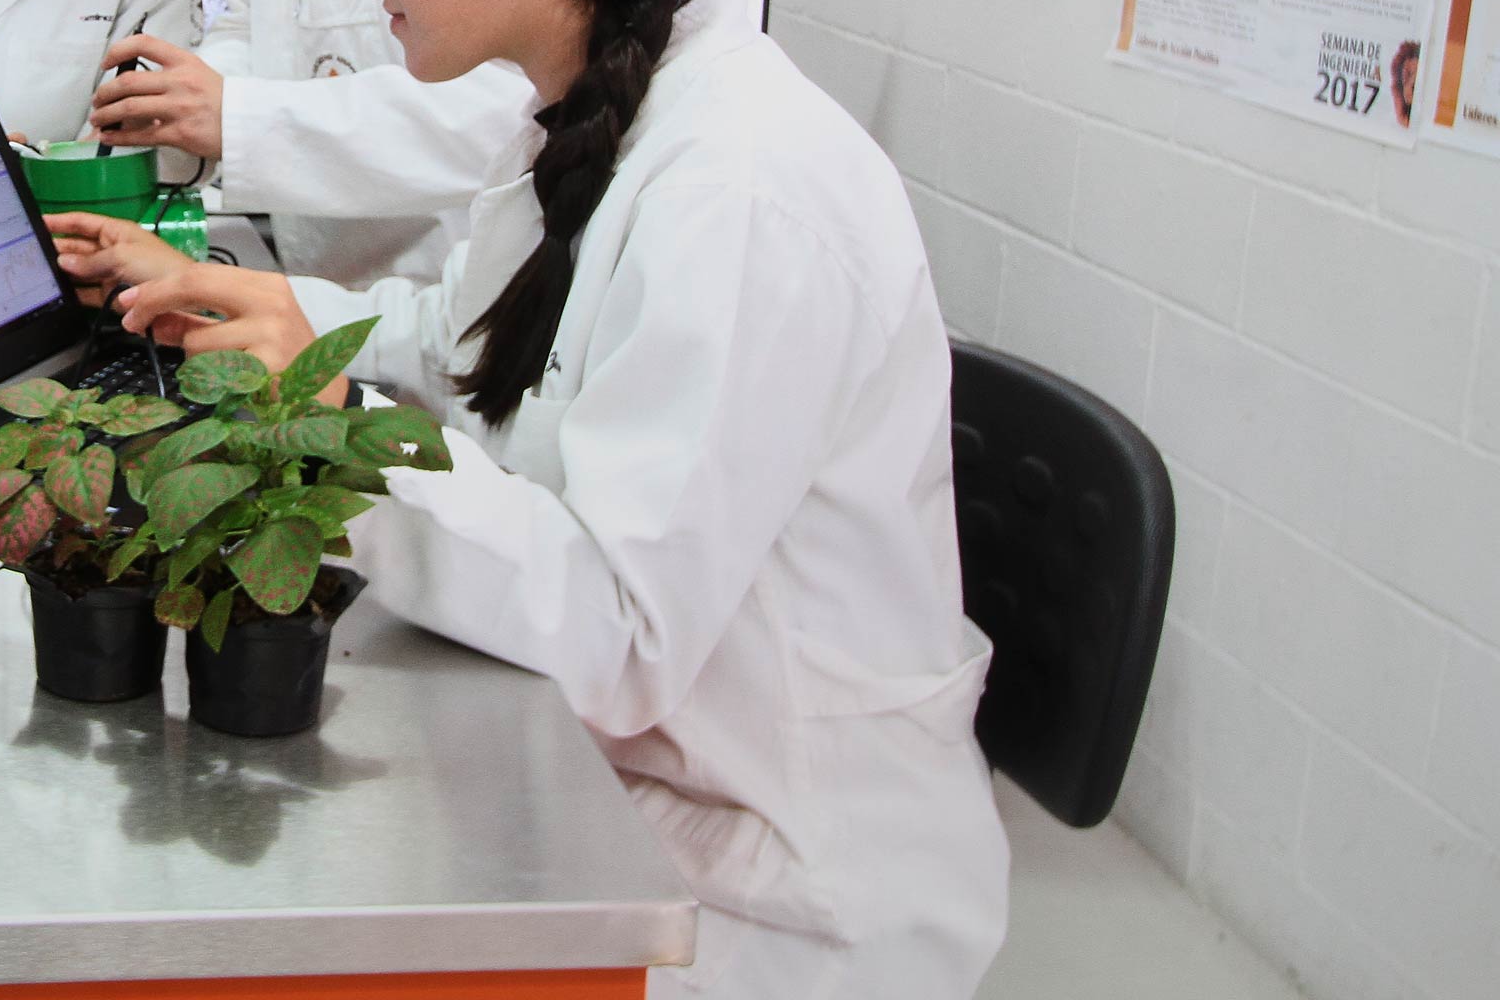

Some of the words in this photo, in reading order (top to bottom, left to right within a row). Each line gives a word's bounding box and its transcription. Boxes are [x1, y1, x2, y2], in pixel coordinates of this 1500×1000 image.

[1321, 32, 1365, 57] SEMANA
[1367, 41, 1381, 60] DE
[1314, 69, 1380, 115] 2017
